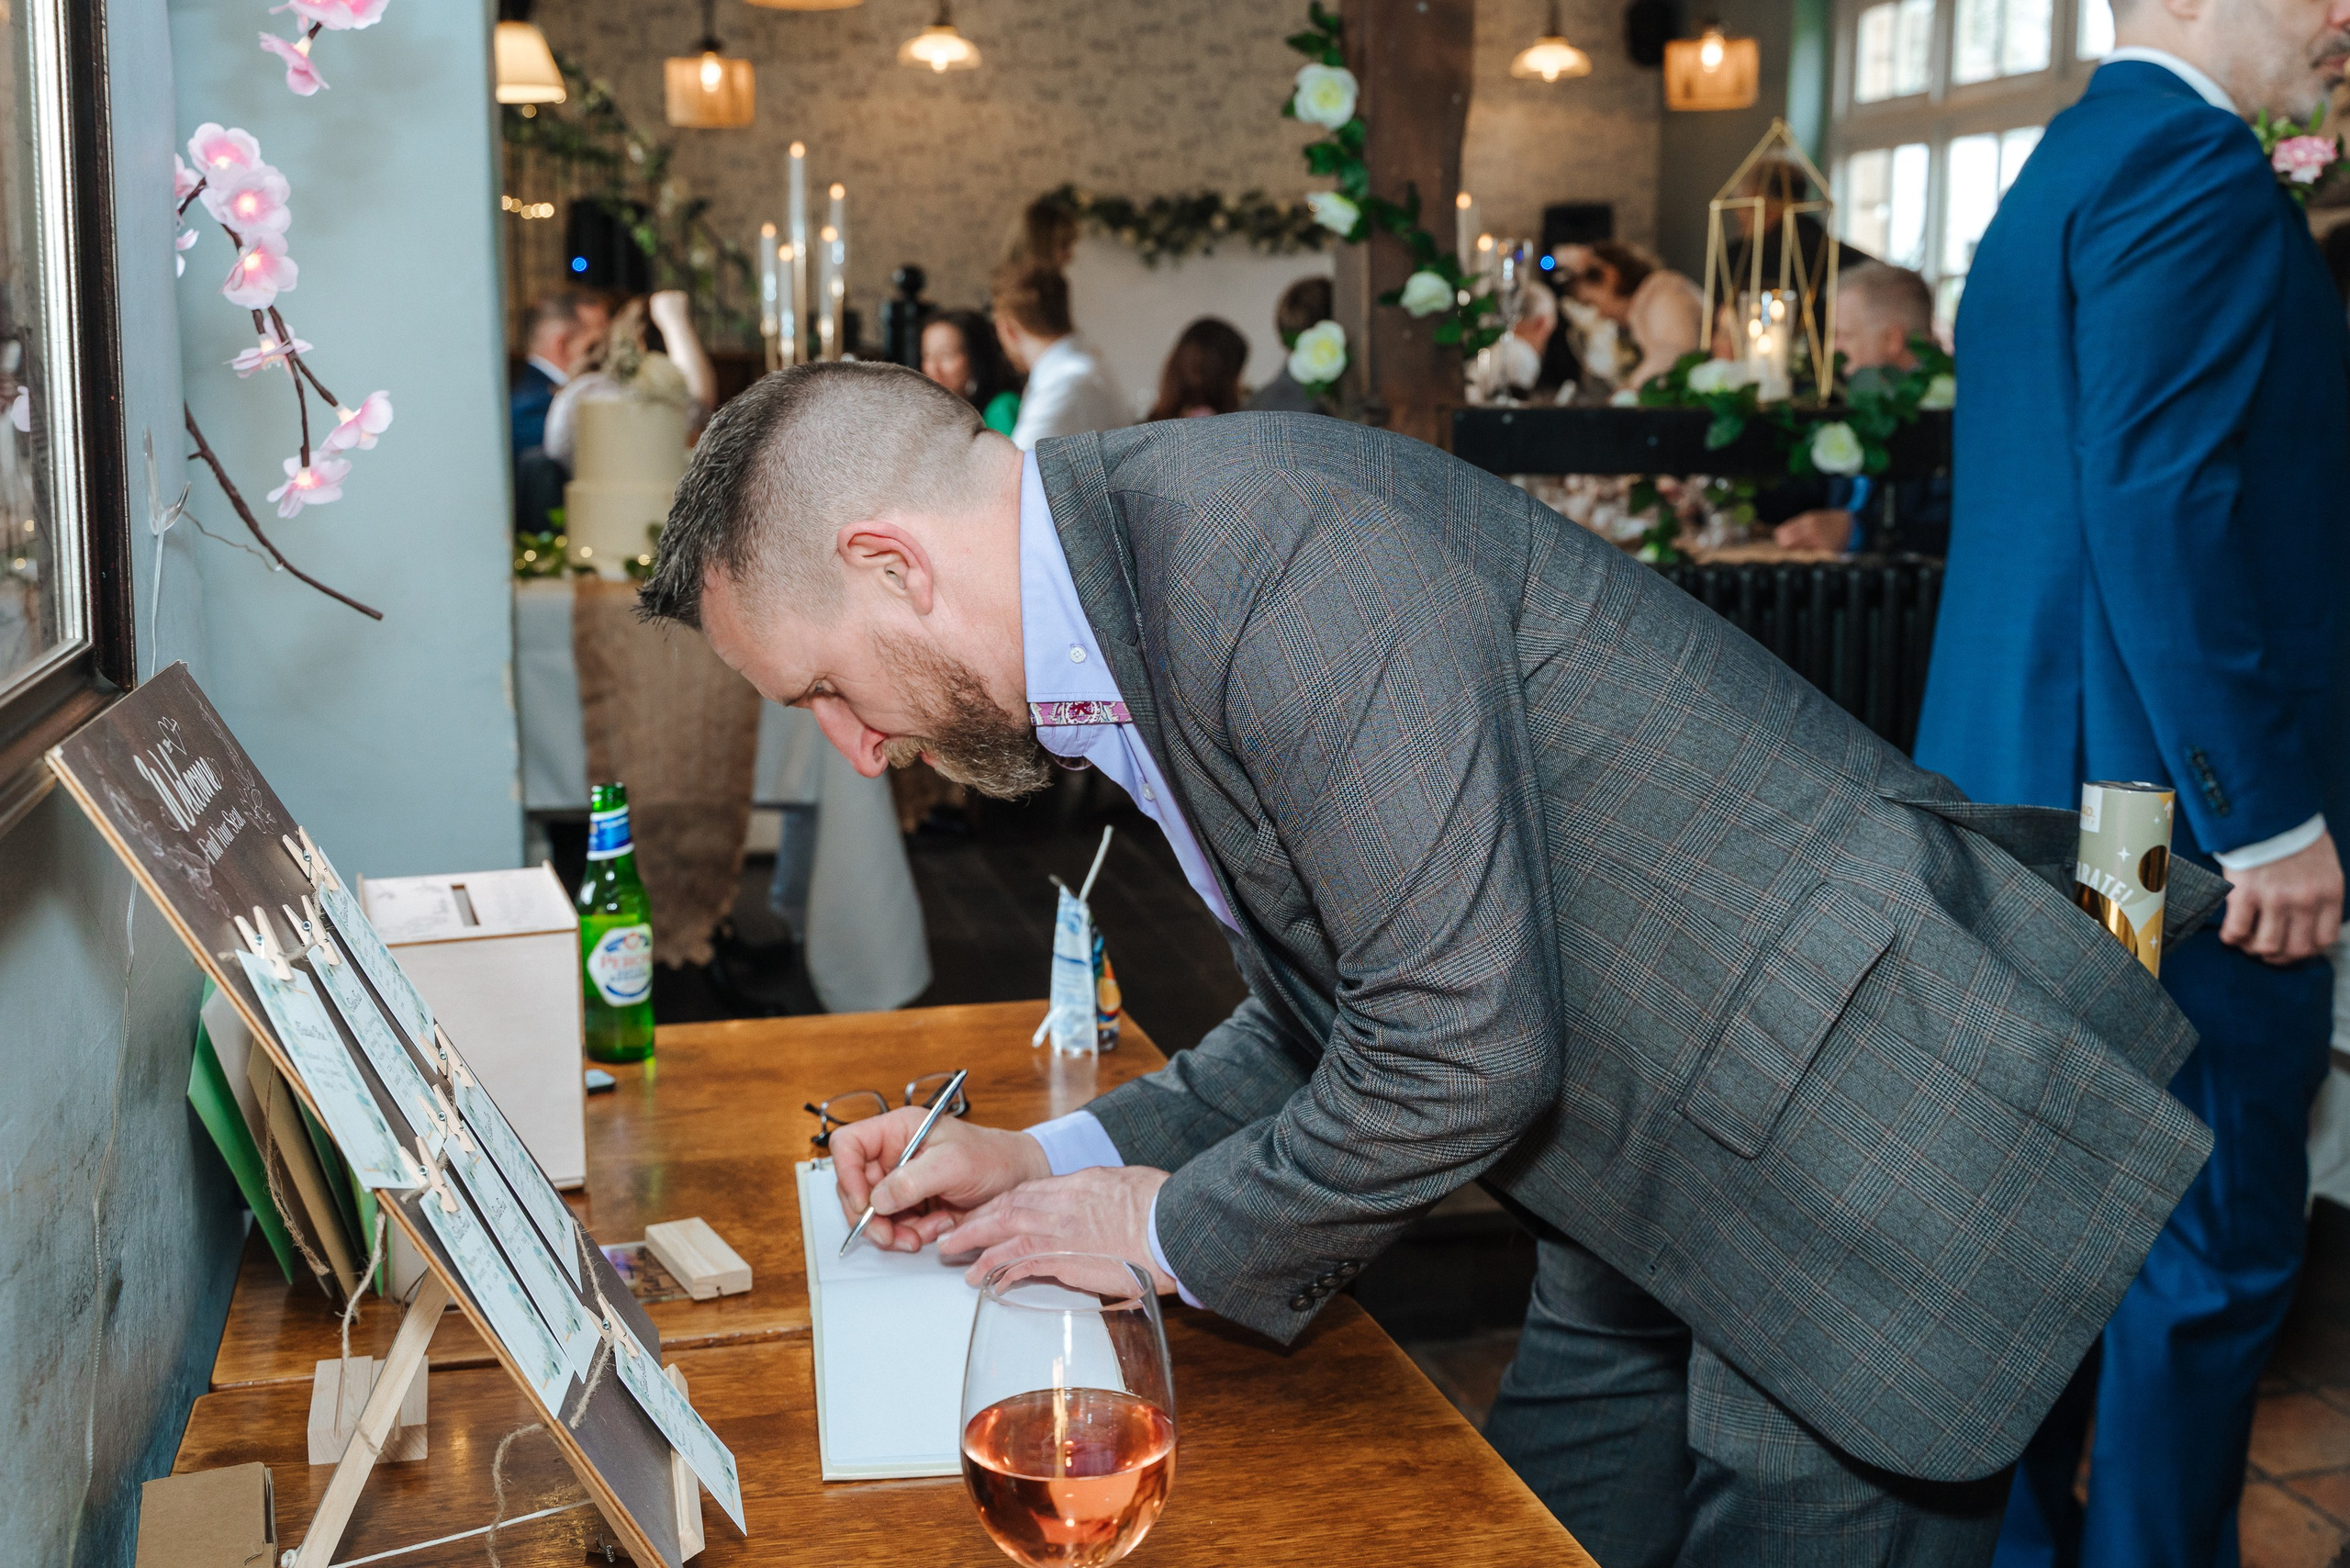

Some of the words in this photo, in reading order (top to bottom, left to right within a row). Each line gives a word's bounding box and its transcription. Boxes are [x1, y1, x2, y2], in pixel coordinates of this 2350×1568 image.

[133, 744, 222, 832] Welcome
[221, 804, 247, 834] Seat
[196, 829, 224, 866] Find
[209, 823, 235, 849] Your
